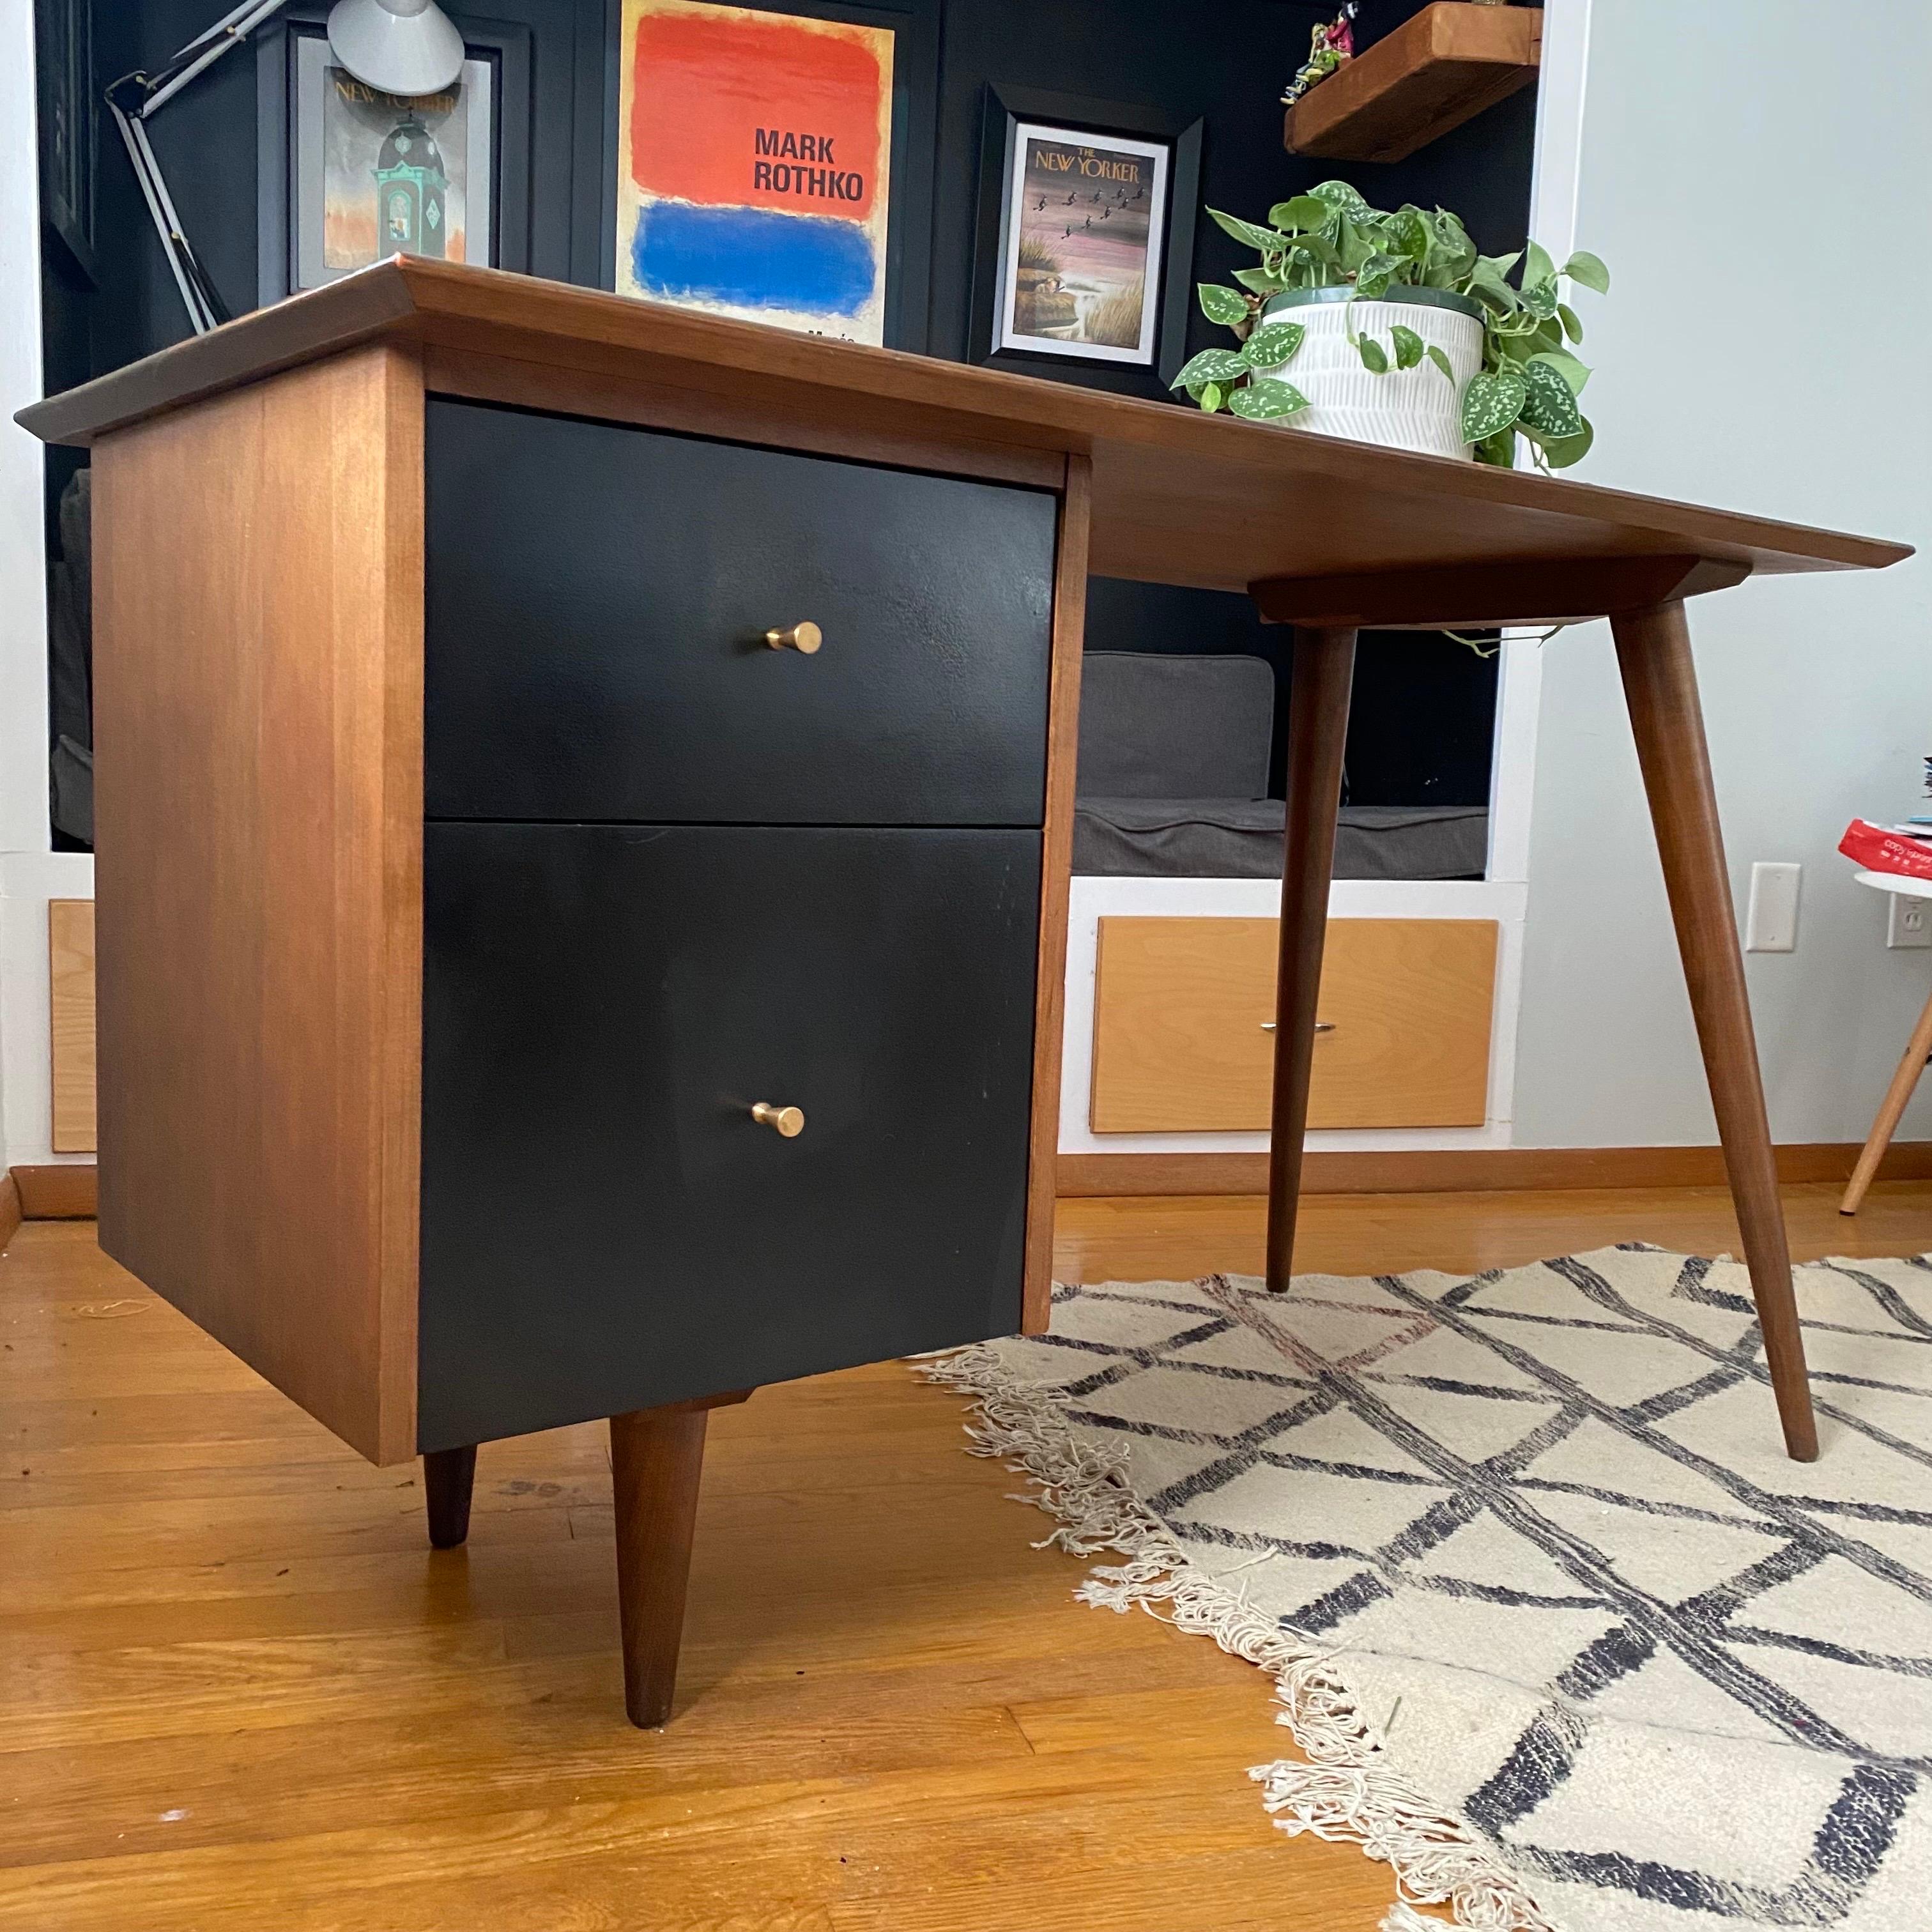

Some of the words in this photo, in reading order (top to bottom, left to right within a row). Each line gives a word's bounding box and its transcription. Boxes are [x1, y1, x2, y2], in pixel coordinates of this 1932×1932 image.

[755, 128, 834, 164] MARK
[1077, 147, 1096, 158] THE
[754, 161, 863, 201] ROTHKO
[1036, 150, 1075, 172] NEW
[1078, 156, 1140, 183] YORKER
